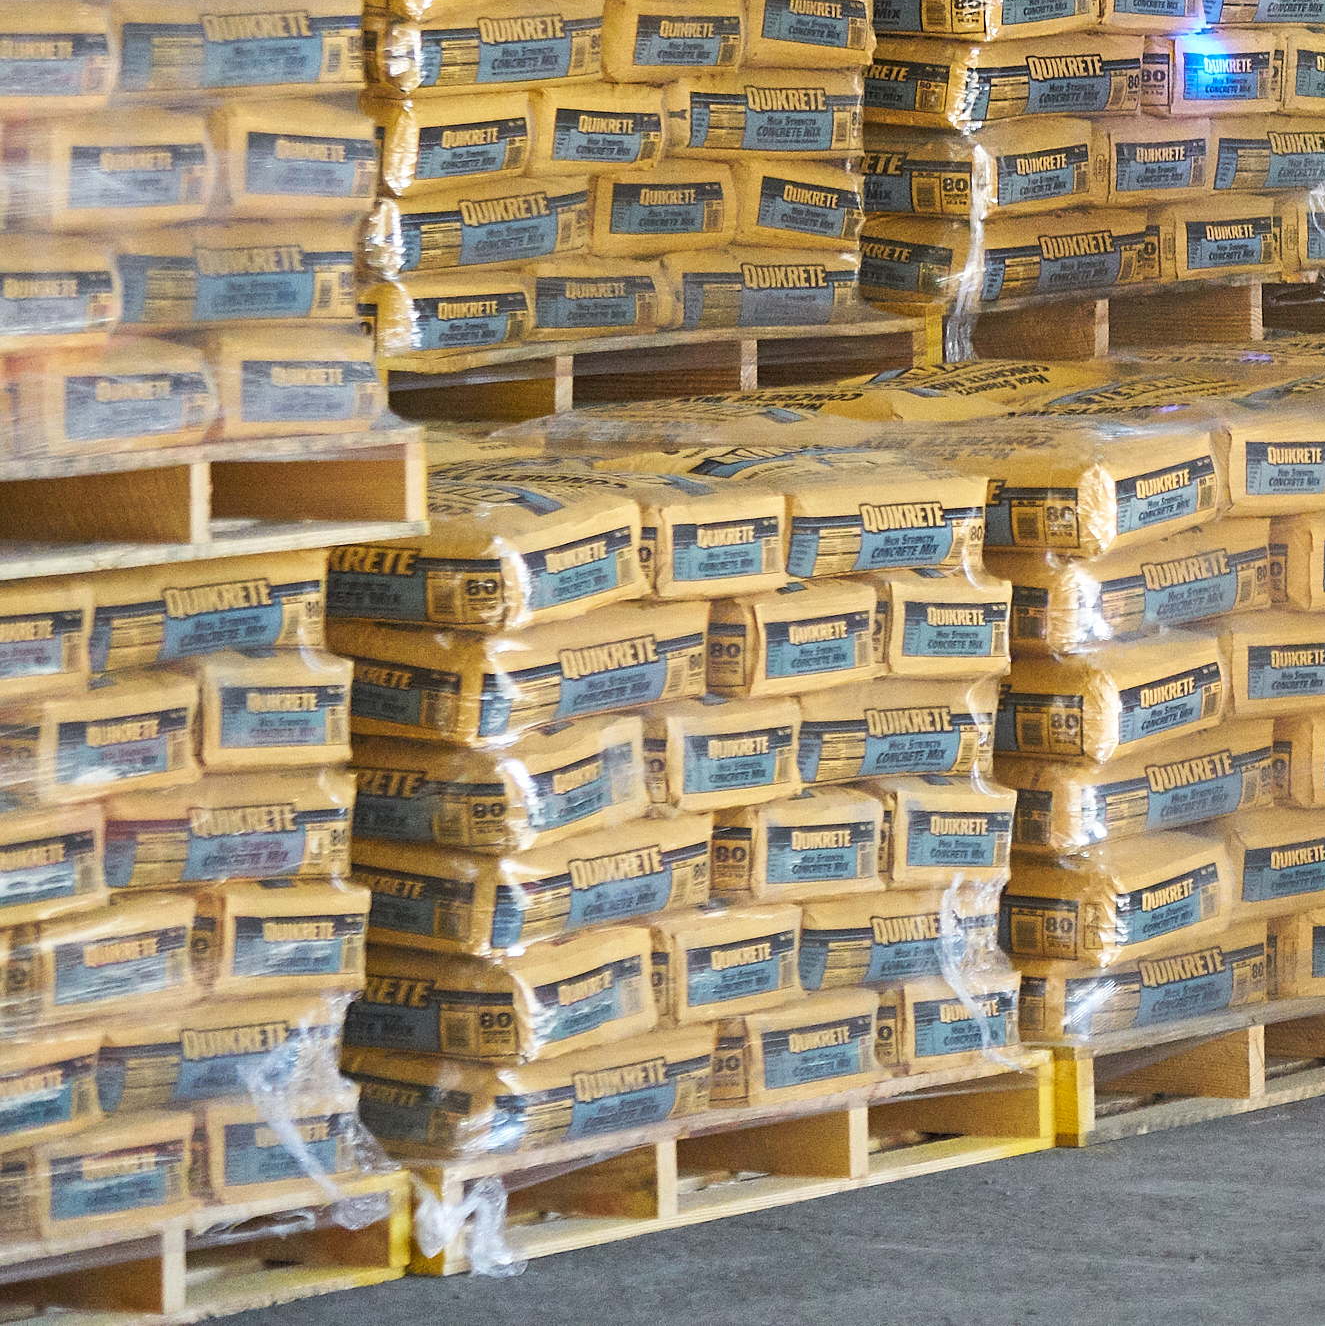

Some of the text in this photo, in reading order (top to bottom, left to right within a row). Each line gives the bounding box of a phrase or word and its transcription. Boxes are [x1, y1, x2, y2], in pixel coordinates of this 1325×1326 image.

[480, 16, 566, 42] QUIKRETE
[1029, 54, 1103, 79] QUIKRETE
[745, 88, 827, 111] QUIKRETE
[745, 265, 827, 289] QUIKRETE
[1267, 444, 1323, 467] QUIKRETE
[1135, 472, 1192, 500] QUIKRETE
[860, 503, 945, 532] QUIKRETE
[927, 605, 986, 626] QUIKRETE
[559, 637, 658, 679] QUIKRETE
[710, 642, 743, 661] 80
[866, 708, 952, 735] QUIKRETE
[569, 848, 663, 888] QUIKRETE
[1139, 948, 1226, 990] QUIKRETE
